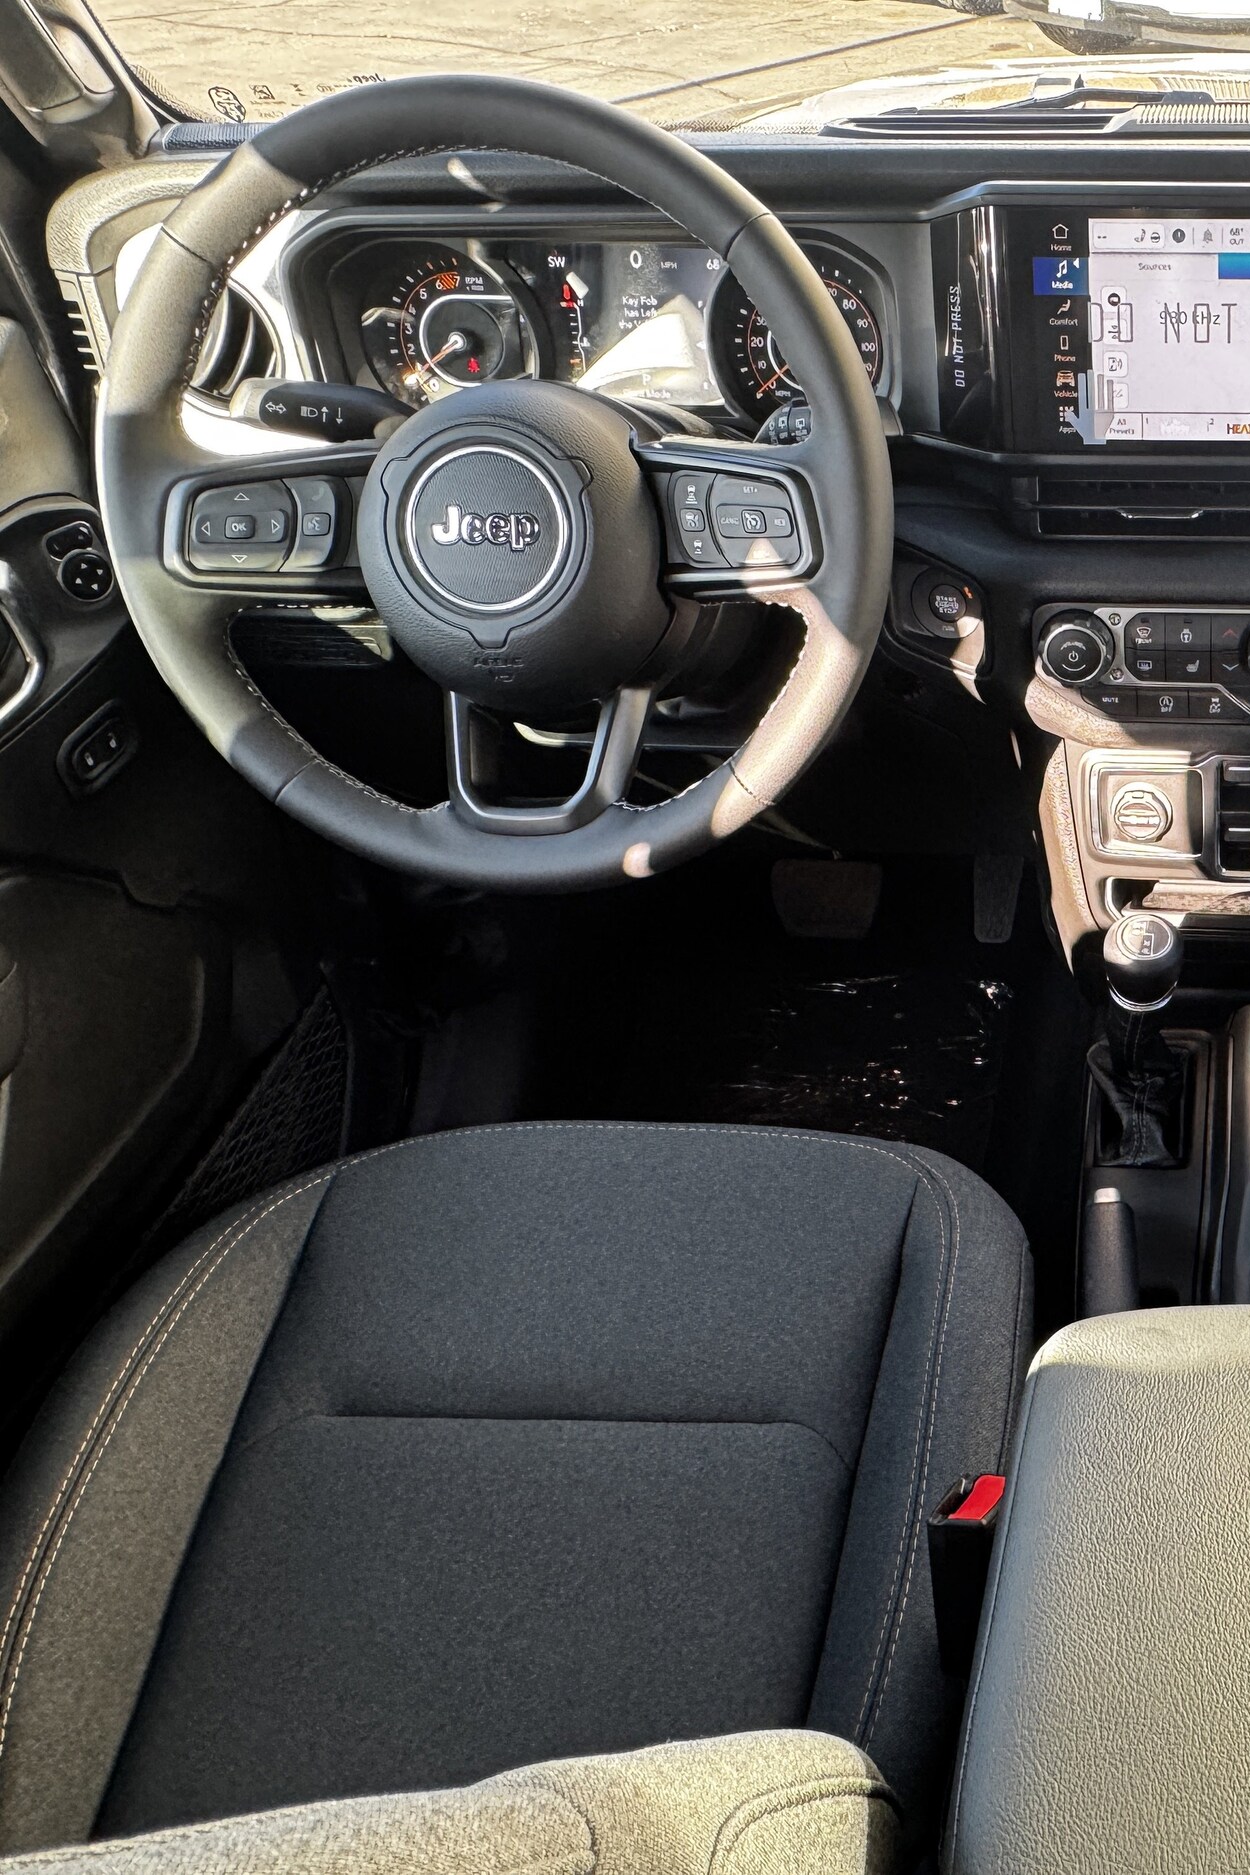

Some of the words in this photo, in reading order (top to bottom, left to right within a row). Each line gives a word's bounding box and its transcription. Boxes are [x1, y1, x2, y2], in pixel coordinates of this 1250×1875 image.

[1050, 244, 1072, 252] Home
[547, 256, 566, 268] SW
[629, 250, 643, 269] 0
[435, 280, 443, 290] 6
[454, 276, 460, 287] 7
[419, 288, 428, 299] 5
[622, 295, 639, 307] Key
[640, 295, 658, 306] Fob
[842, 299, 857, 310] 80
[408, 304, 416, 315] 4
[624, 308, 639, 318] has
[949, 285, 962, 331] PRESS
[857, 319, 869, 328] 90
[1050, 318, 1078, 326] Comfort
[1164, 302, 1237, 344] NOT
[405, 322, 413, 334] 3
[750, 337, 764, 348] 20
[861, 342, 875, 352] 100
[407, 343, 416, 355] 2
[1054, 354, 1076, 362] Phone
[758, 361, 767, 369] 10
[642, 373, 652, 386] P
[954, 369, 966, 388] DO
[231, 522, 246, 532] OK
[431, 504, 541, 552] Jeep
